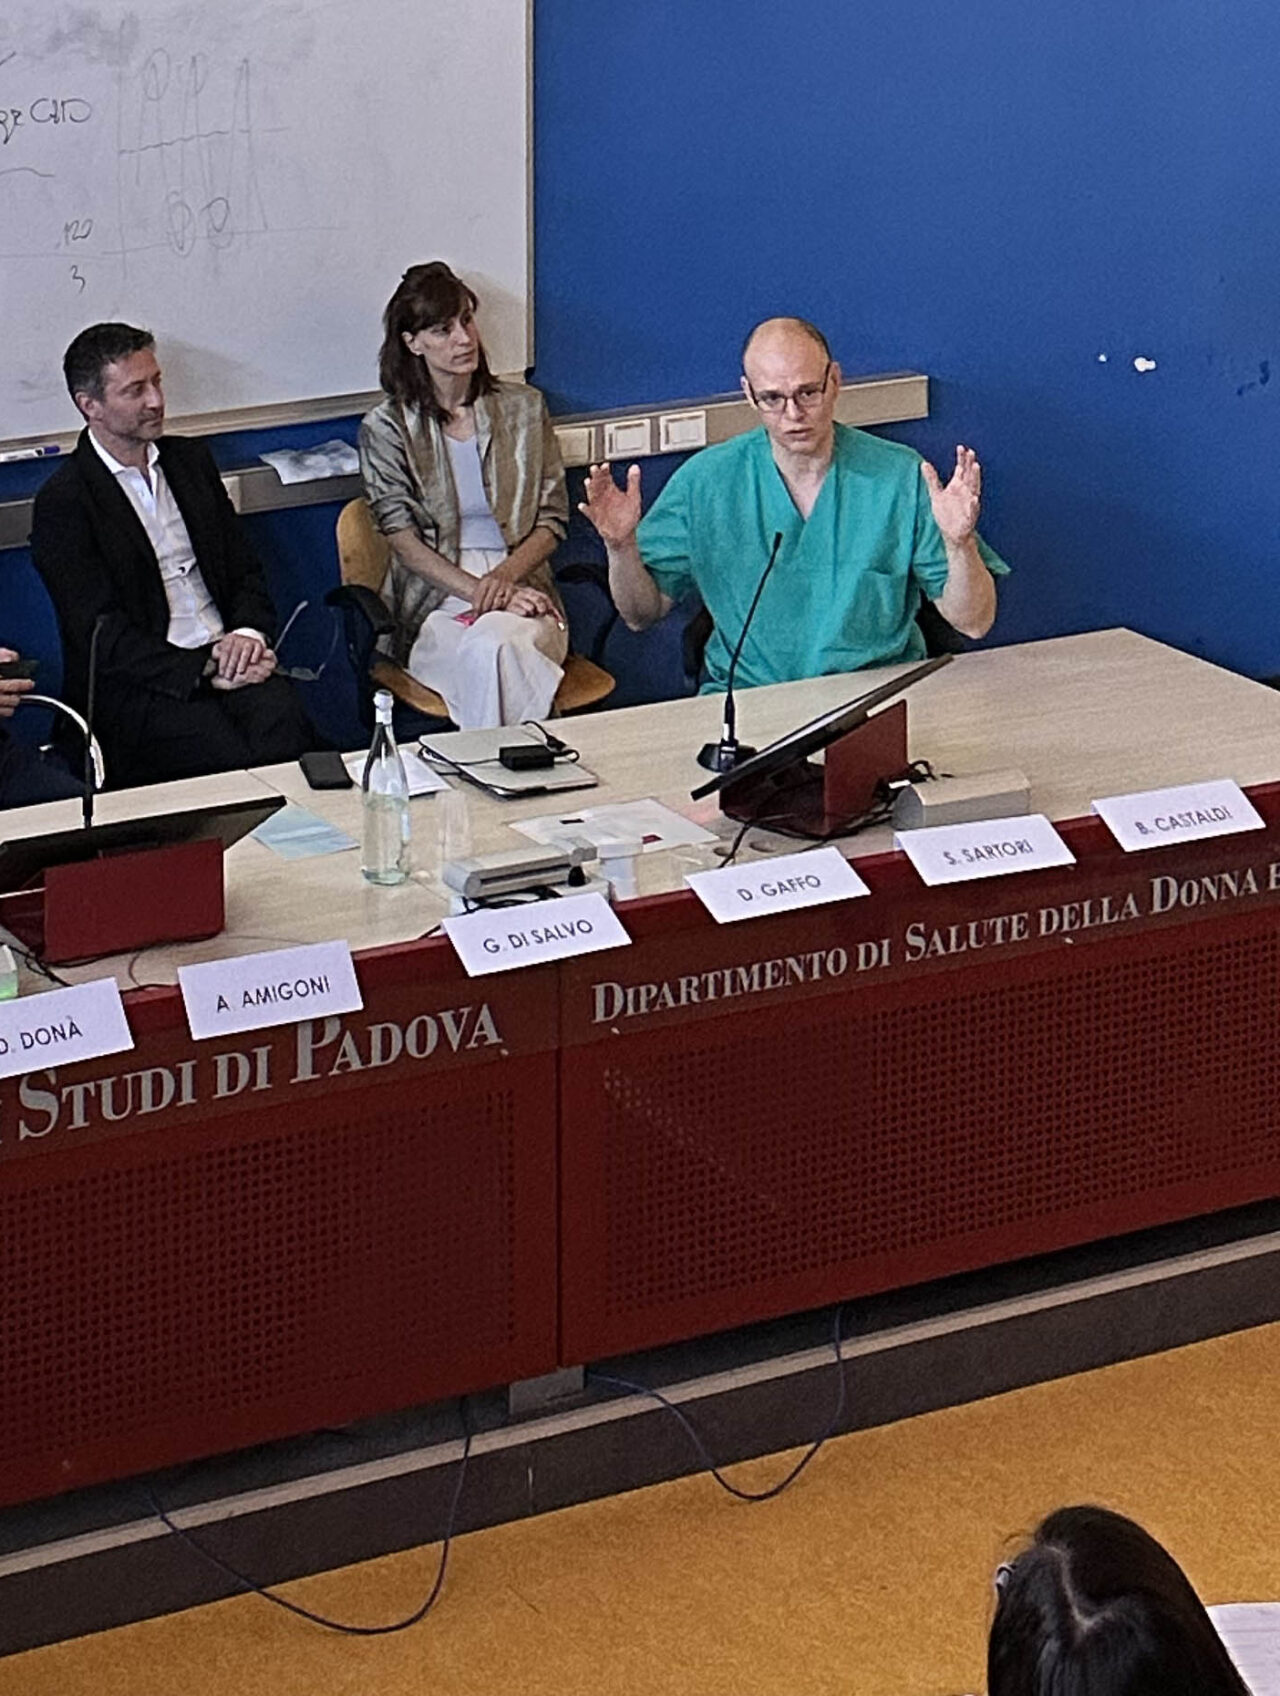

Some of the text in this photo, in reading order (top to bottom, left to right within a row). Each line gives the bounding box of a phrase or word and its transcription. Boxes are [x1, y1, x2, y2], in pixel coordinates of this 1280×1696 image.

[1157, 806, 1233, 832] CASTALDI
[966, 838, 1033, 864] SARTORI
[761, 874, 821, 898] GAFFO
[509, 931, 528, 950] DI
[531, 919, 594, 945] SALVO
[591, 947, 848, 1024] DIPARTIMENTO
[856, 938, 892, 972] DI
[904, 911, 1029, 963] SALUTE
[1039, 892, 1141, 937] DELLA
[1149, 867, 1259, 916] DONNA
[242, 975, 331, 1008] AMIGONI
[20, 1015, 84, 1050] DONÀ
[18, 1060, 200, 1141] STUDI
[212, 1045, 273, 1100] DI
[289, 1004, 504, 1085] PADOVA
